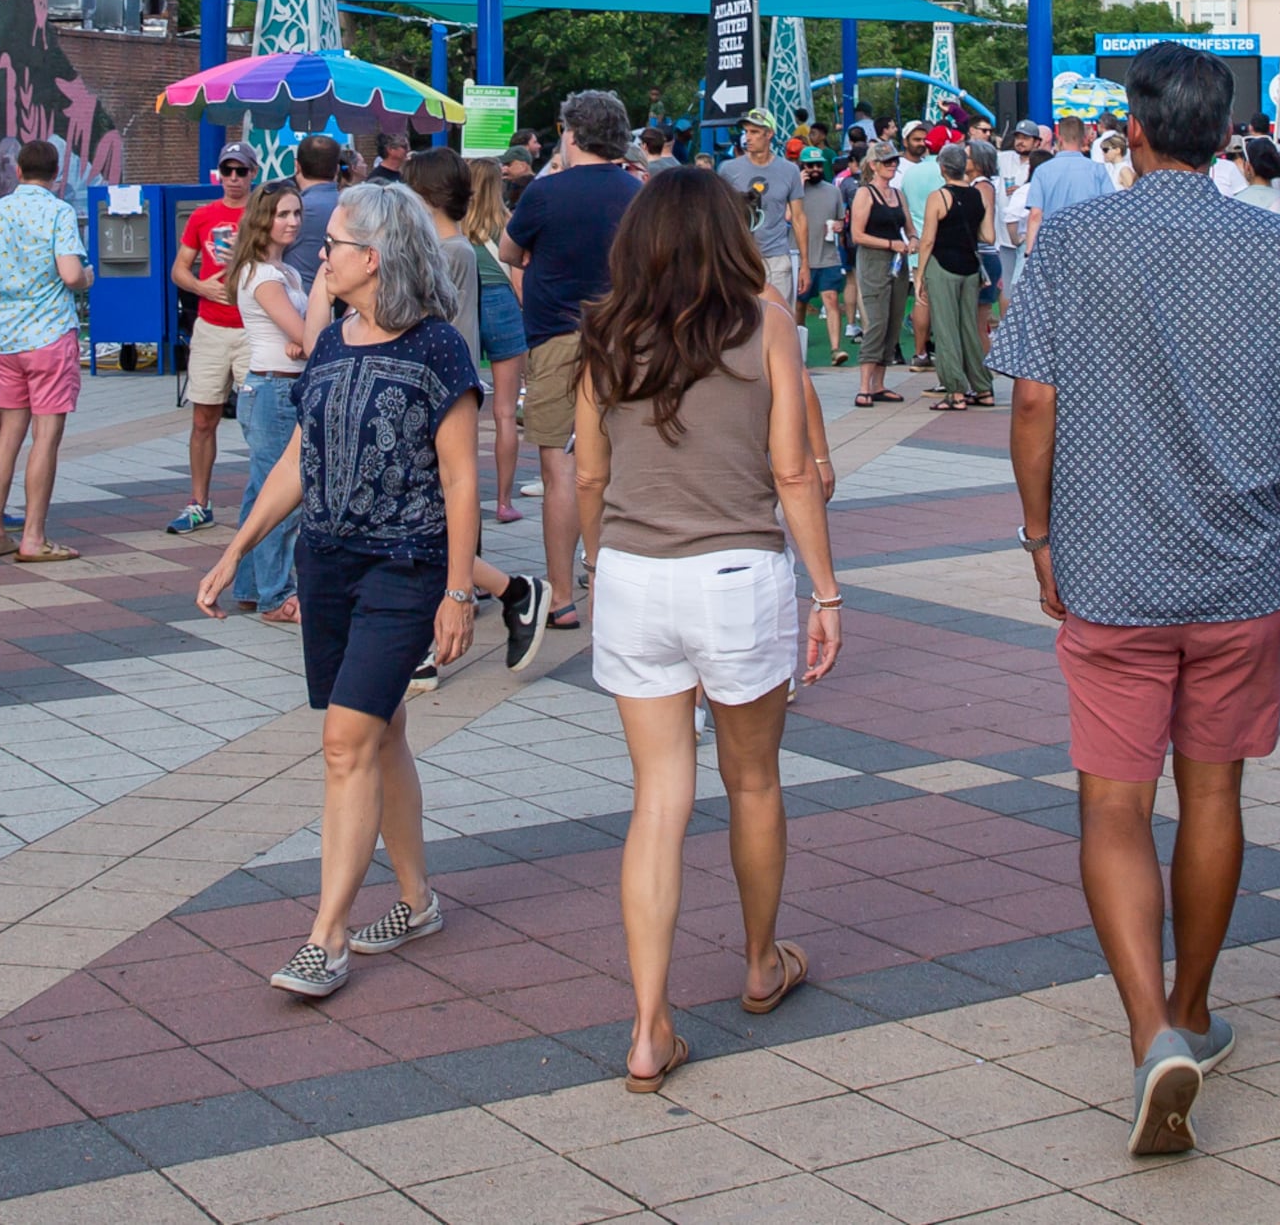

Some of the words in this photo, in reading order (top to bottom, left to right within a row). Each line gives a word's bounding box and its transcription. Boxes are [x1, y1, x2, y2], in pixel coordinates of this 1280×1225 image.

[715, 0, 752, 19] ATLANTA
[718, 18, 748, 35] UNITED
[719, 37, 744, 52] SKILL
[718, 54, 742, 69] ZONE
